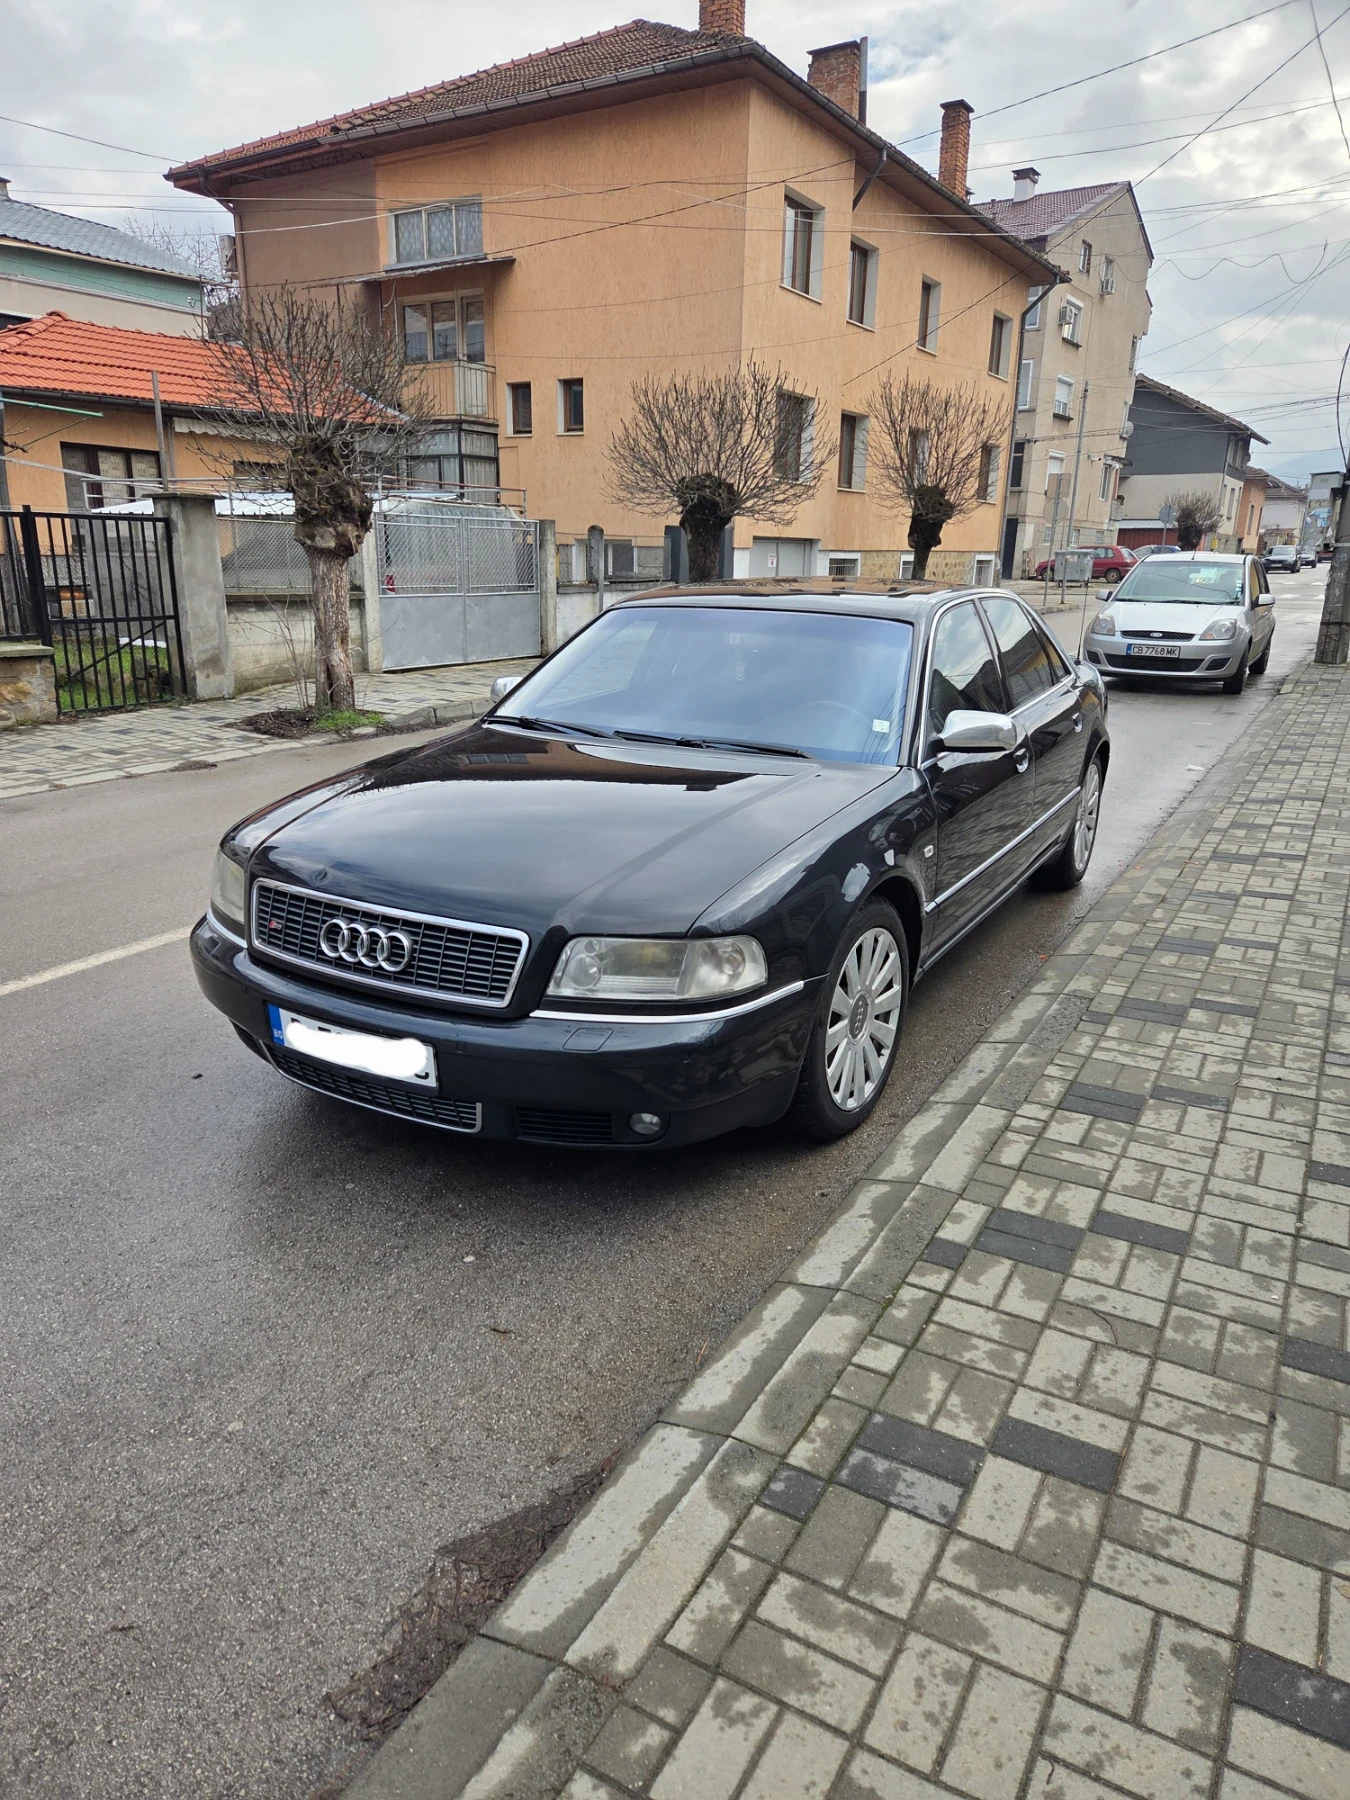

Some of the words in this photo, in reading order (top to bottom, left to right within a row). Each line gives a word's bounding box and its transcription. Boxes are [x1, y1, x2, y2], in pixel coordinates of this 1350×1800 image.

[1132, 646, 1144, 654] CB
[1144, 647, 1165, 655] 7768
[1165, 648, 1178, 656] MK
[273, 1028, 283, 1039] BG
